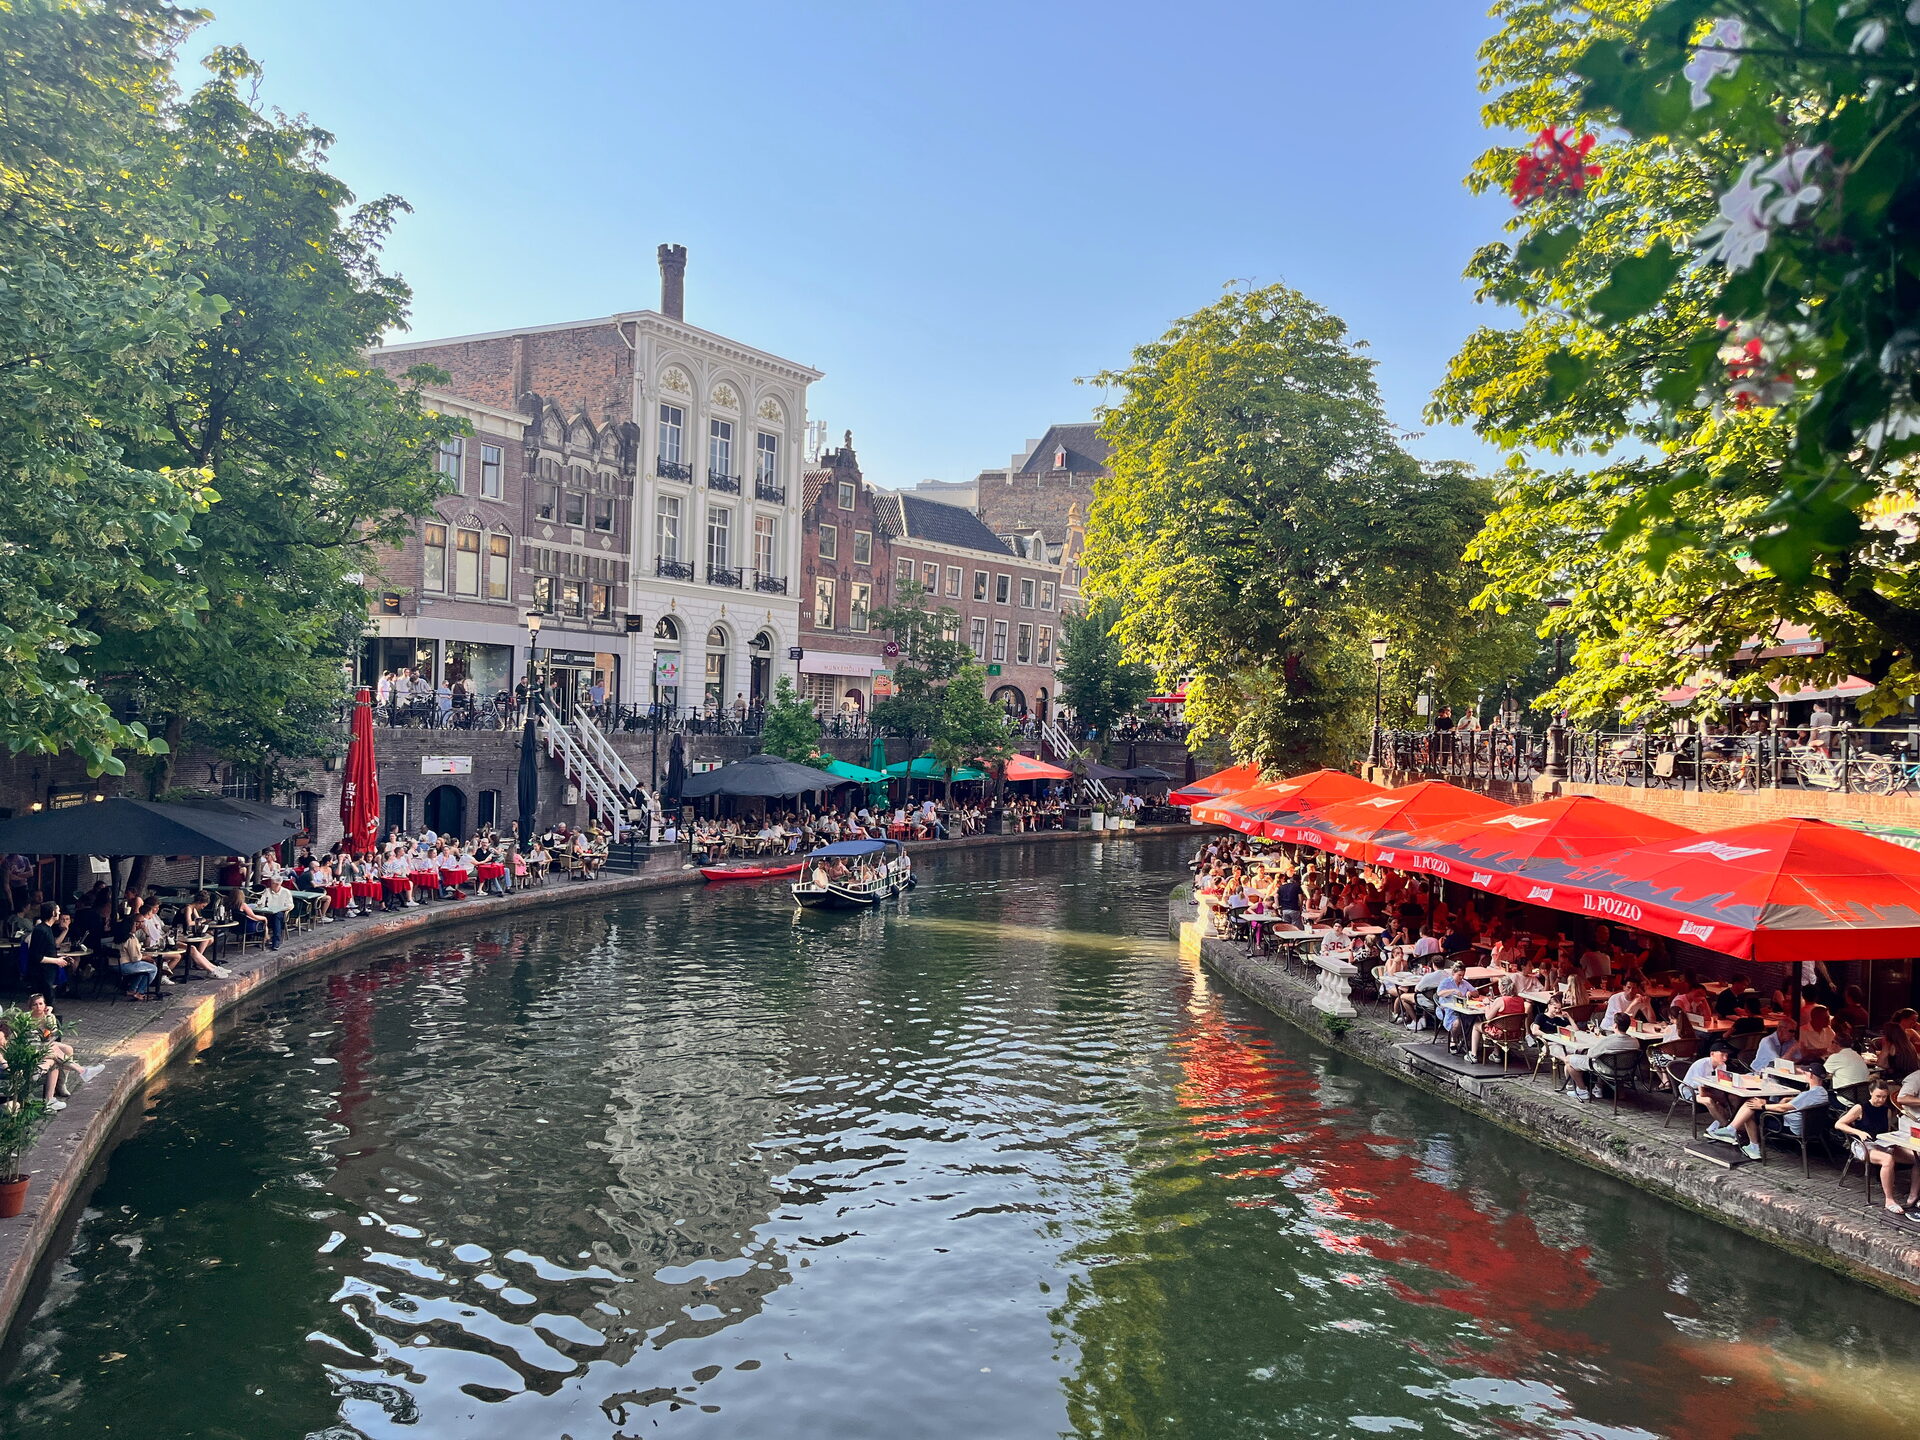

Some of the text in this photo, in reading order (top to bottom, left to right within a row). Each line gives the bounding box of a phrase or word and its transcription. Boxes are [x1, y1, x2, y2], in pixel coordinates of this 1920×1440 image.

[803, 611, 811, 619] 111
[1413, 855, 1421, 868] IL
[1422, 856, 1450, 875] POZZO
[1583, 894, 1642, 921] IL POZZO
[1682, 920, 1712, 938] Bud
